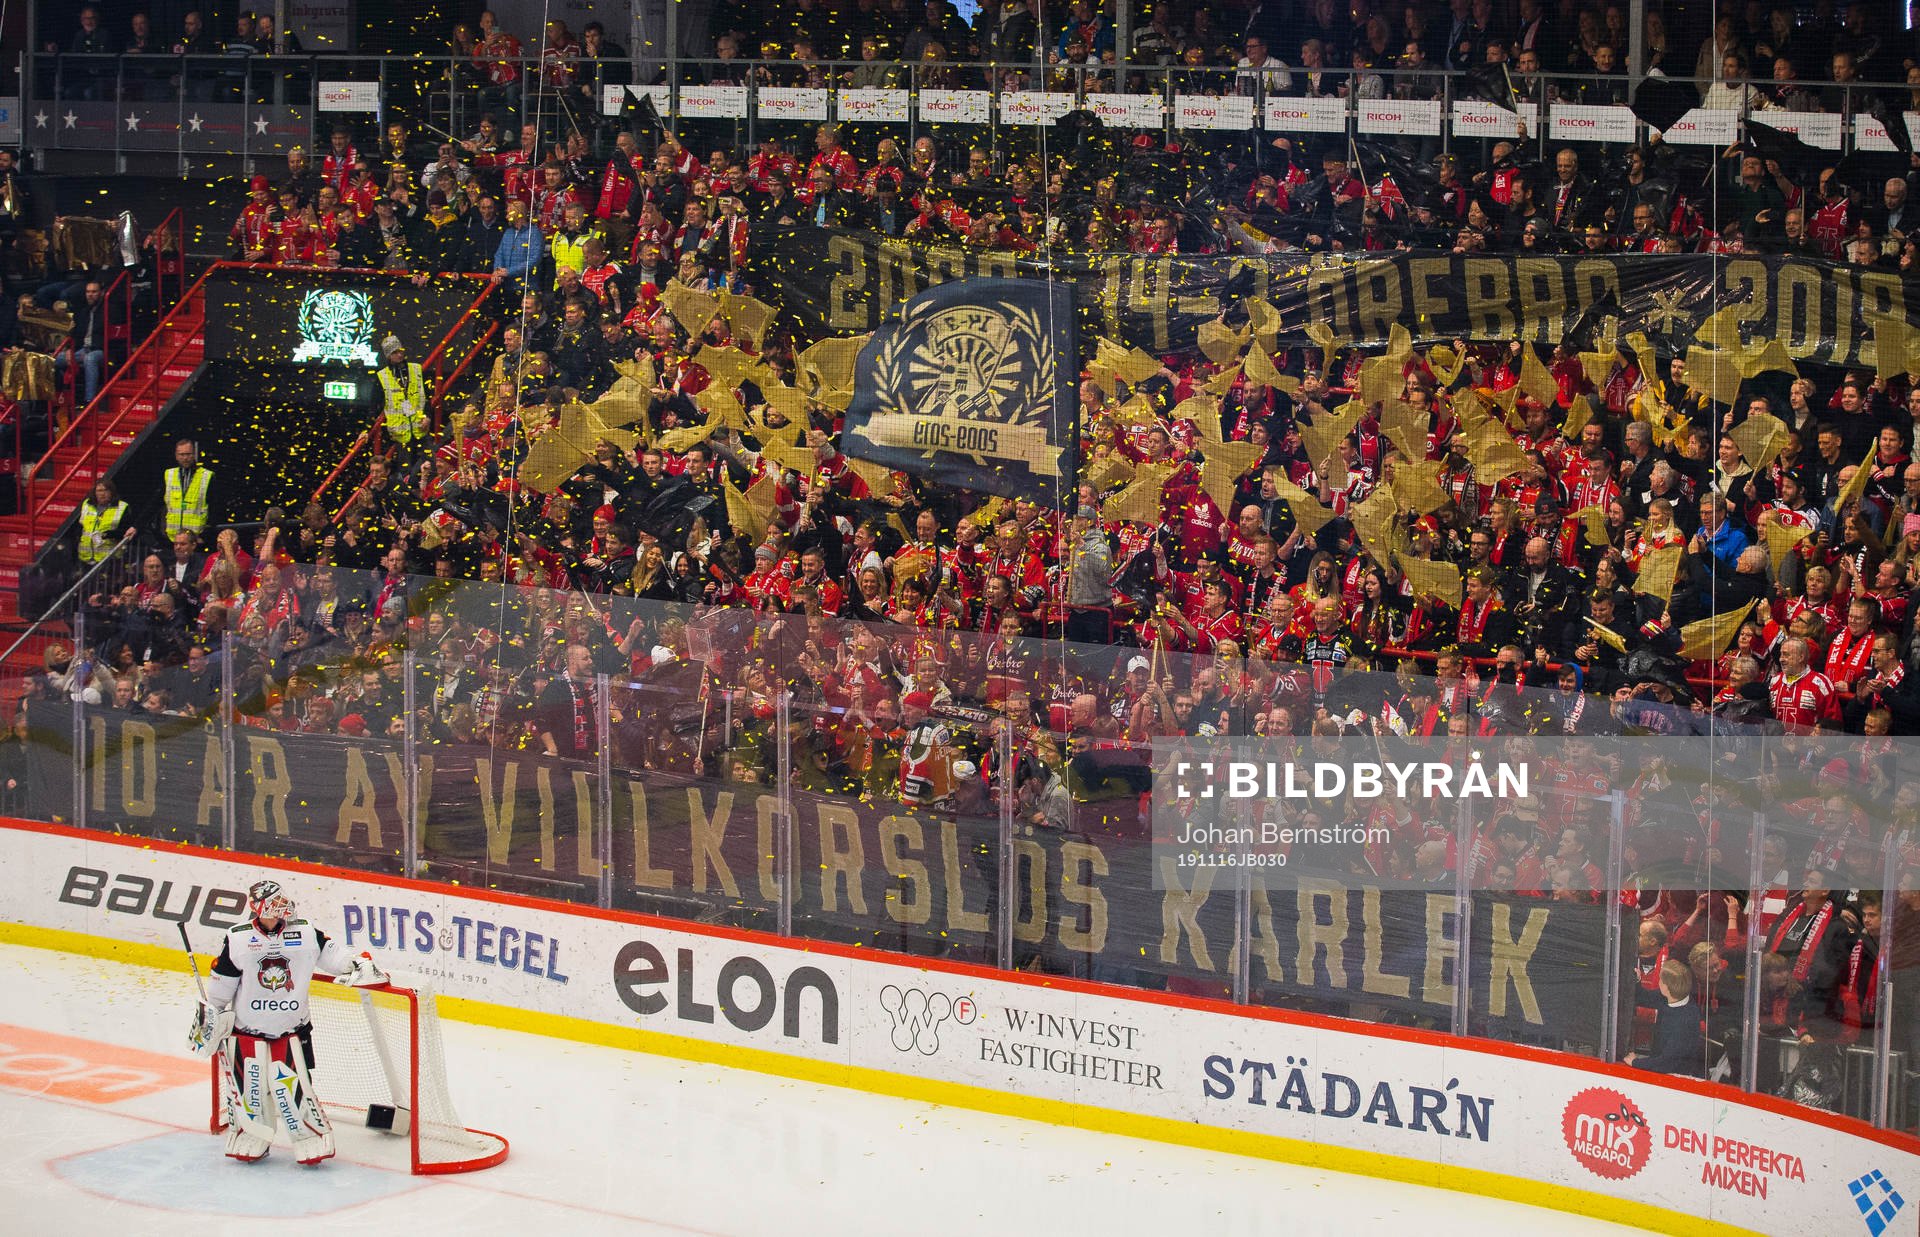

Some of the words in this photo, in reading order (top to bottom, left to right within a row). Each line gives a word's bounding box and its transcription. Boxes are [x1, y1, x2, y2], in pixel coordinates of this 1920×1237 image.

[688, 98, 716, 106] RICOH
[766, 100, 795, 108] RICOH
[1009, 104, 1040, 112] RICOH
[1095, 106, 1126, 114] RICOH
[1184, 108, 1216, 116] RICOH
[1274, 110, 1307, 118] RICOH
[1367, 112, 1402, 121] RICOH
[1462, 115, 1496, 124] RICOH
[1559, 118, 1594, 127] RICOH
[1671, 122, 1696, 130] COH
[1865, 128, 1889, 137] RIC
[1190, 518, 1213, 529] adidas
[91, 716, 156, 817] 10
[197, 720, 292, 836] ÅR
[476, 758, 1109, 954] VILLKORSLÖS
[58, 866, 255, 930] Baue
[343, 904, 435, 954] PUTS
[438, 928, 454, 951] &
[452, 916, 568, 986] TEGEL
[418, 967, 454, 980] SEDAN
[462, 974, 488, 984] 1970
[251, 1000, 300, 1011] areco
[960, 1002, 970, 1020] F
[979, 1038, 1164, 1090] FASTIGHETER
[249, 1064, 260, 1107] bravida
[226, 1096, 234, 1126] CCM
[276, 1087, 298, 1130] bravida
[306, 1097, 324, 1128] CCM
[1575, 1113, 1638, 1156] mix
[1573, 1140, 1633, 1170] MEGAPOL
[1664, 1124, 1708, 1156] DEN
[1713, 1135, 1805, 1183] PERFEKTA
[1702, 1162, 1768, 1200] MIXEN
